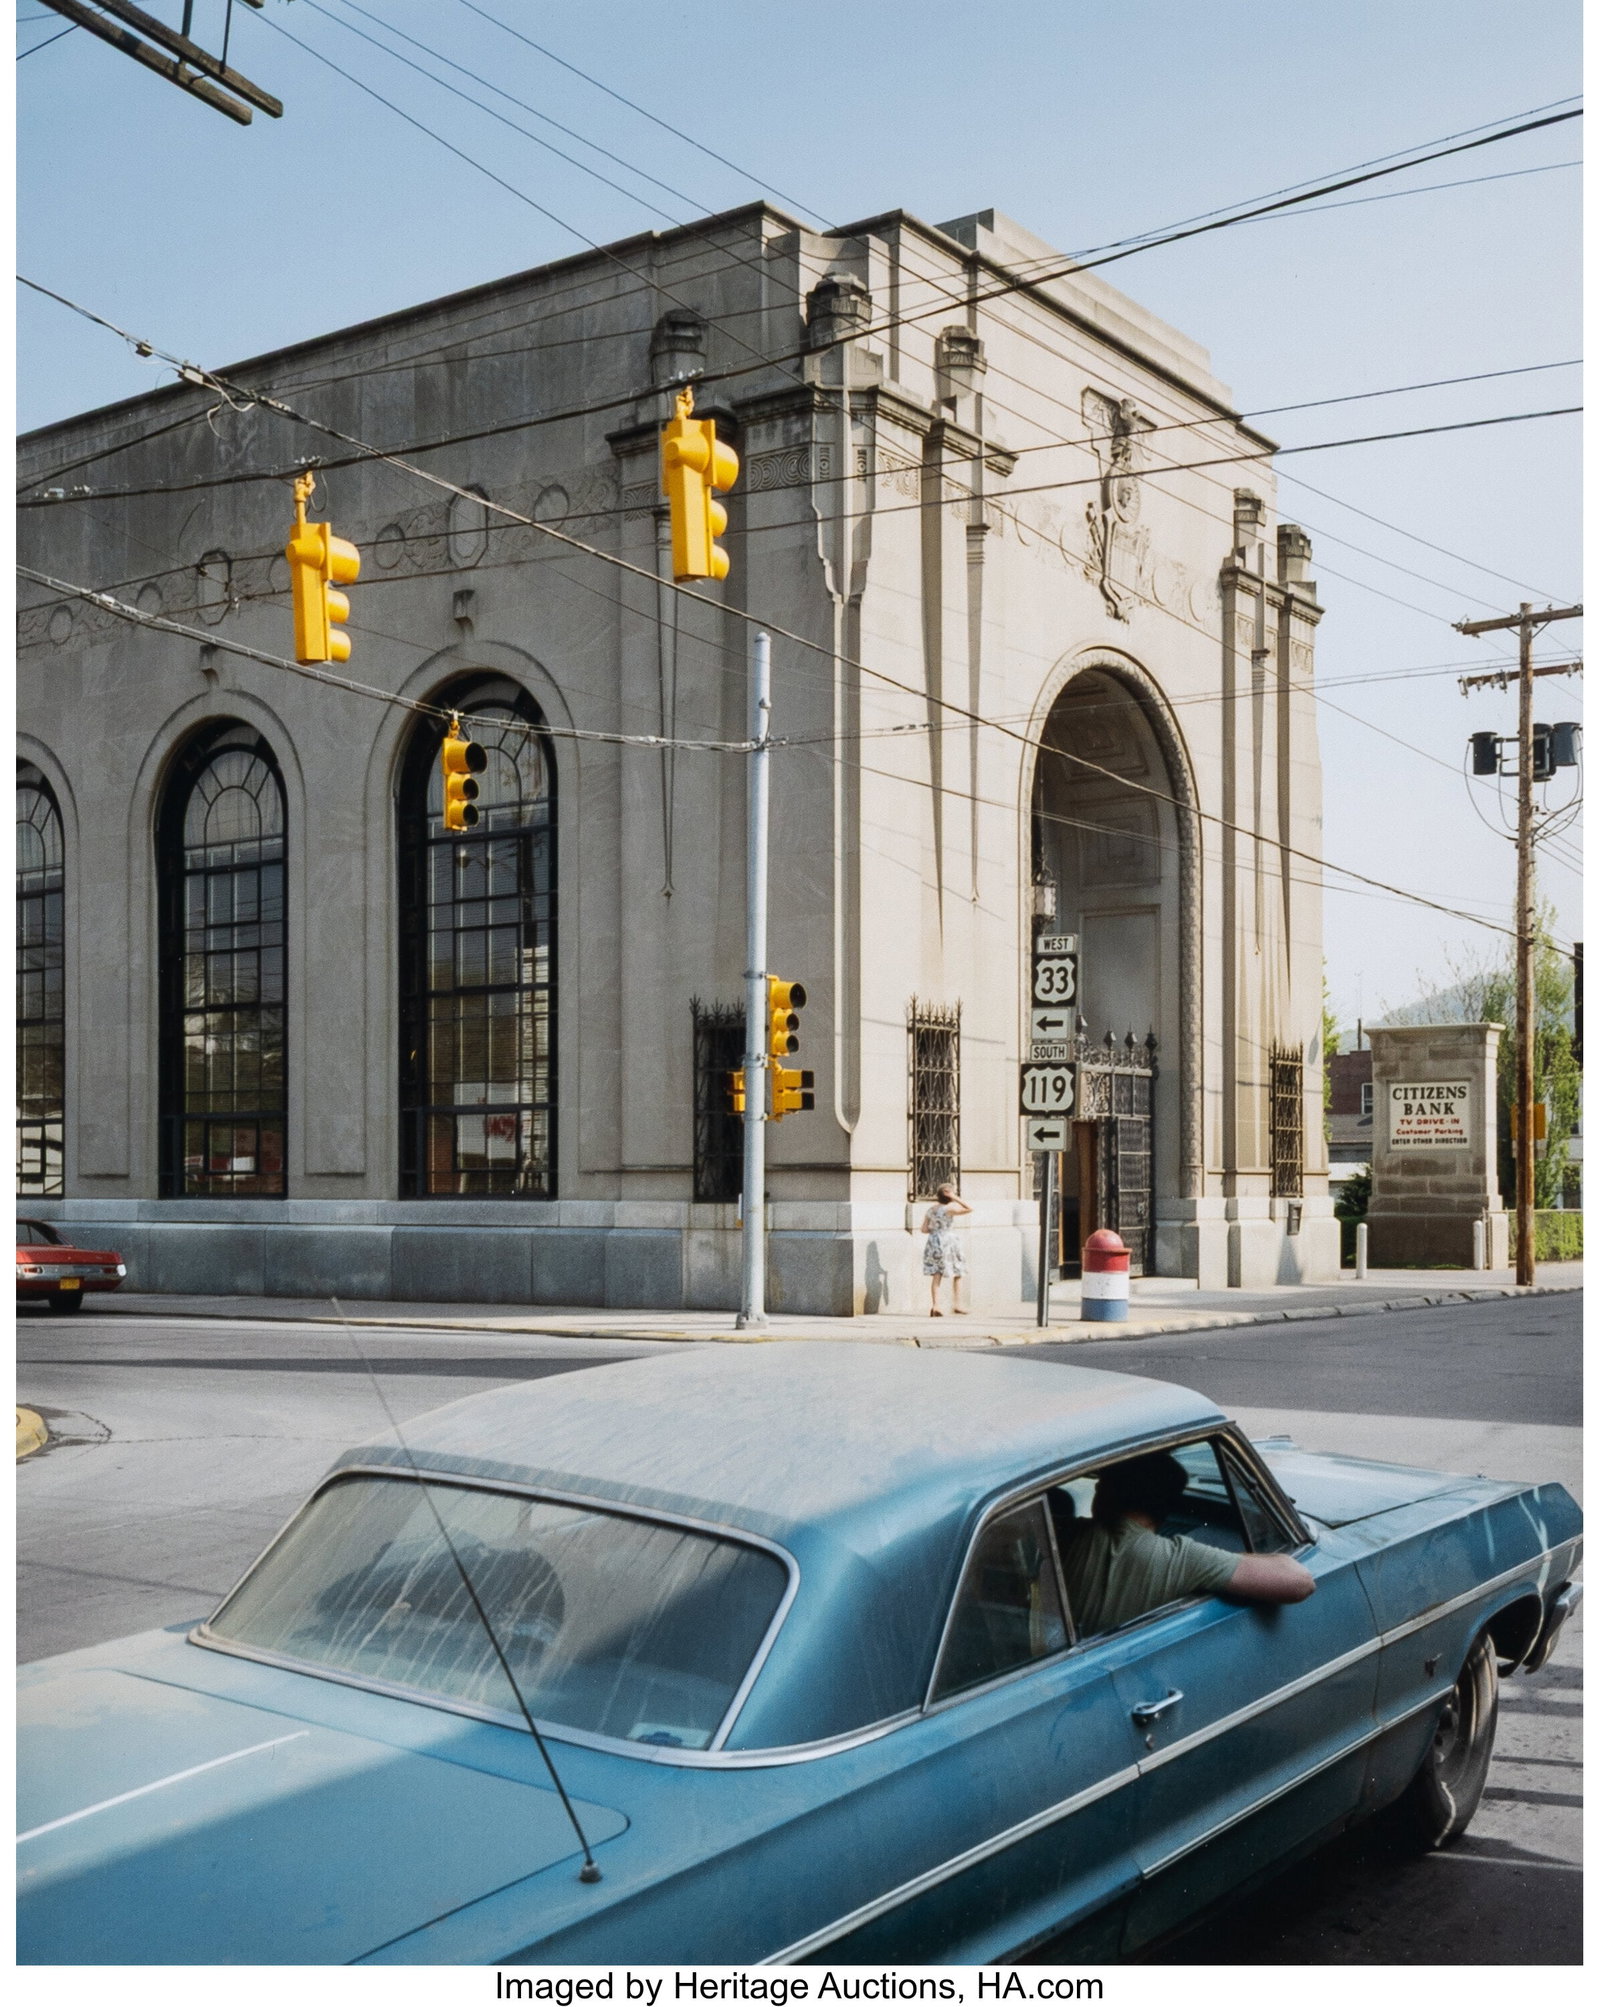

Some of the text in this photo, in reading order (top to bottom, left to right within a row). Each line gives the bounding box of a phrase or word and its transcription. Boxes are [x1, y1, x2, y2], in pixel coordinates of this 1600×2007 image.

[1043, 938, 1068, 951] WEST
[1041, 966, 1069, 994] 33
[1033, 1046, 1065, 1059] SOUTH
[1030, 1075, 1066, 1103] 119
[1392, 1086, 1467, 1100] CITIZENS
[1403, 1102, 1454, 1115] BANK
